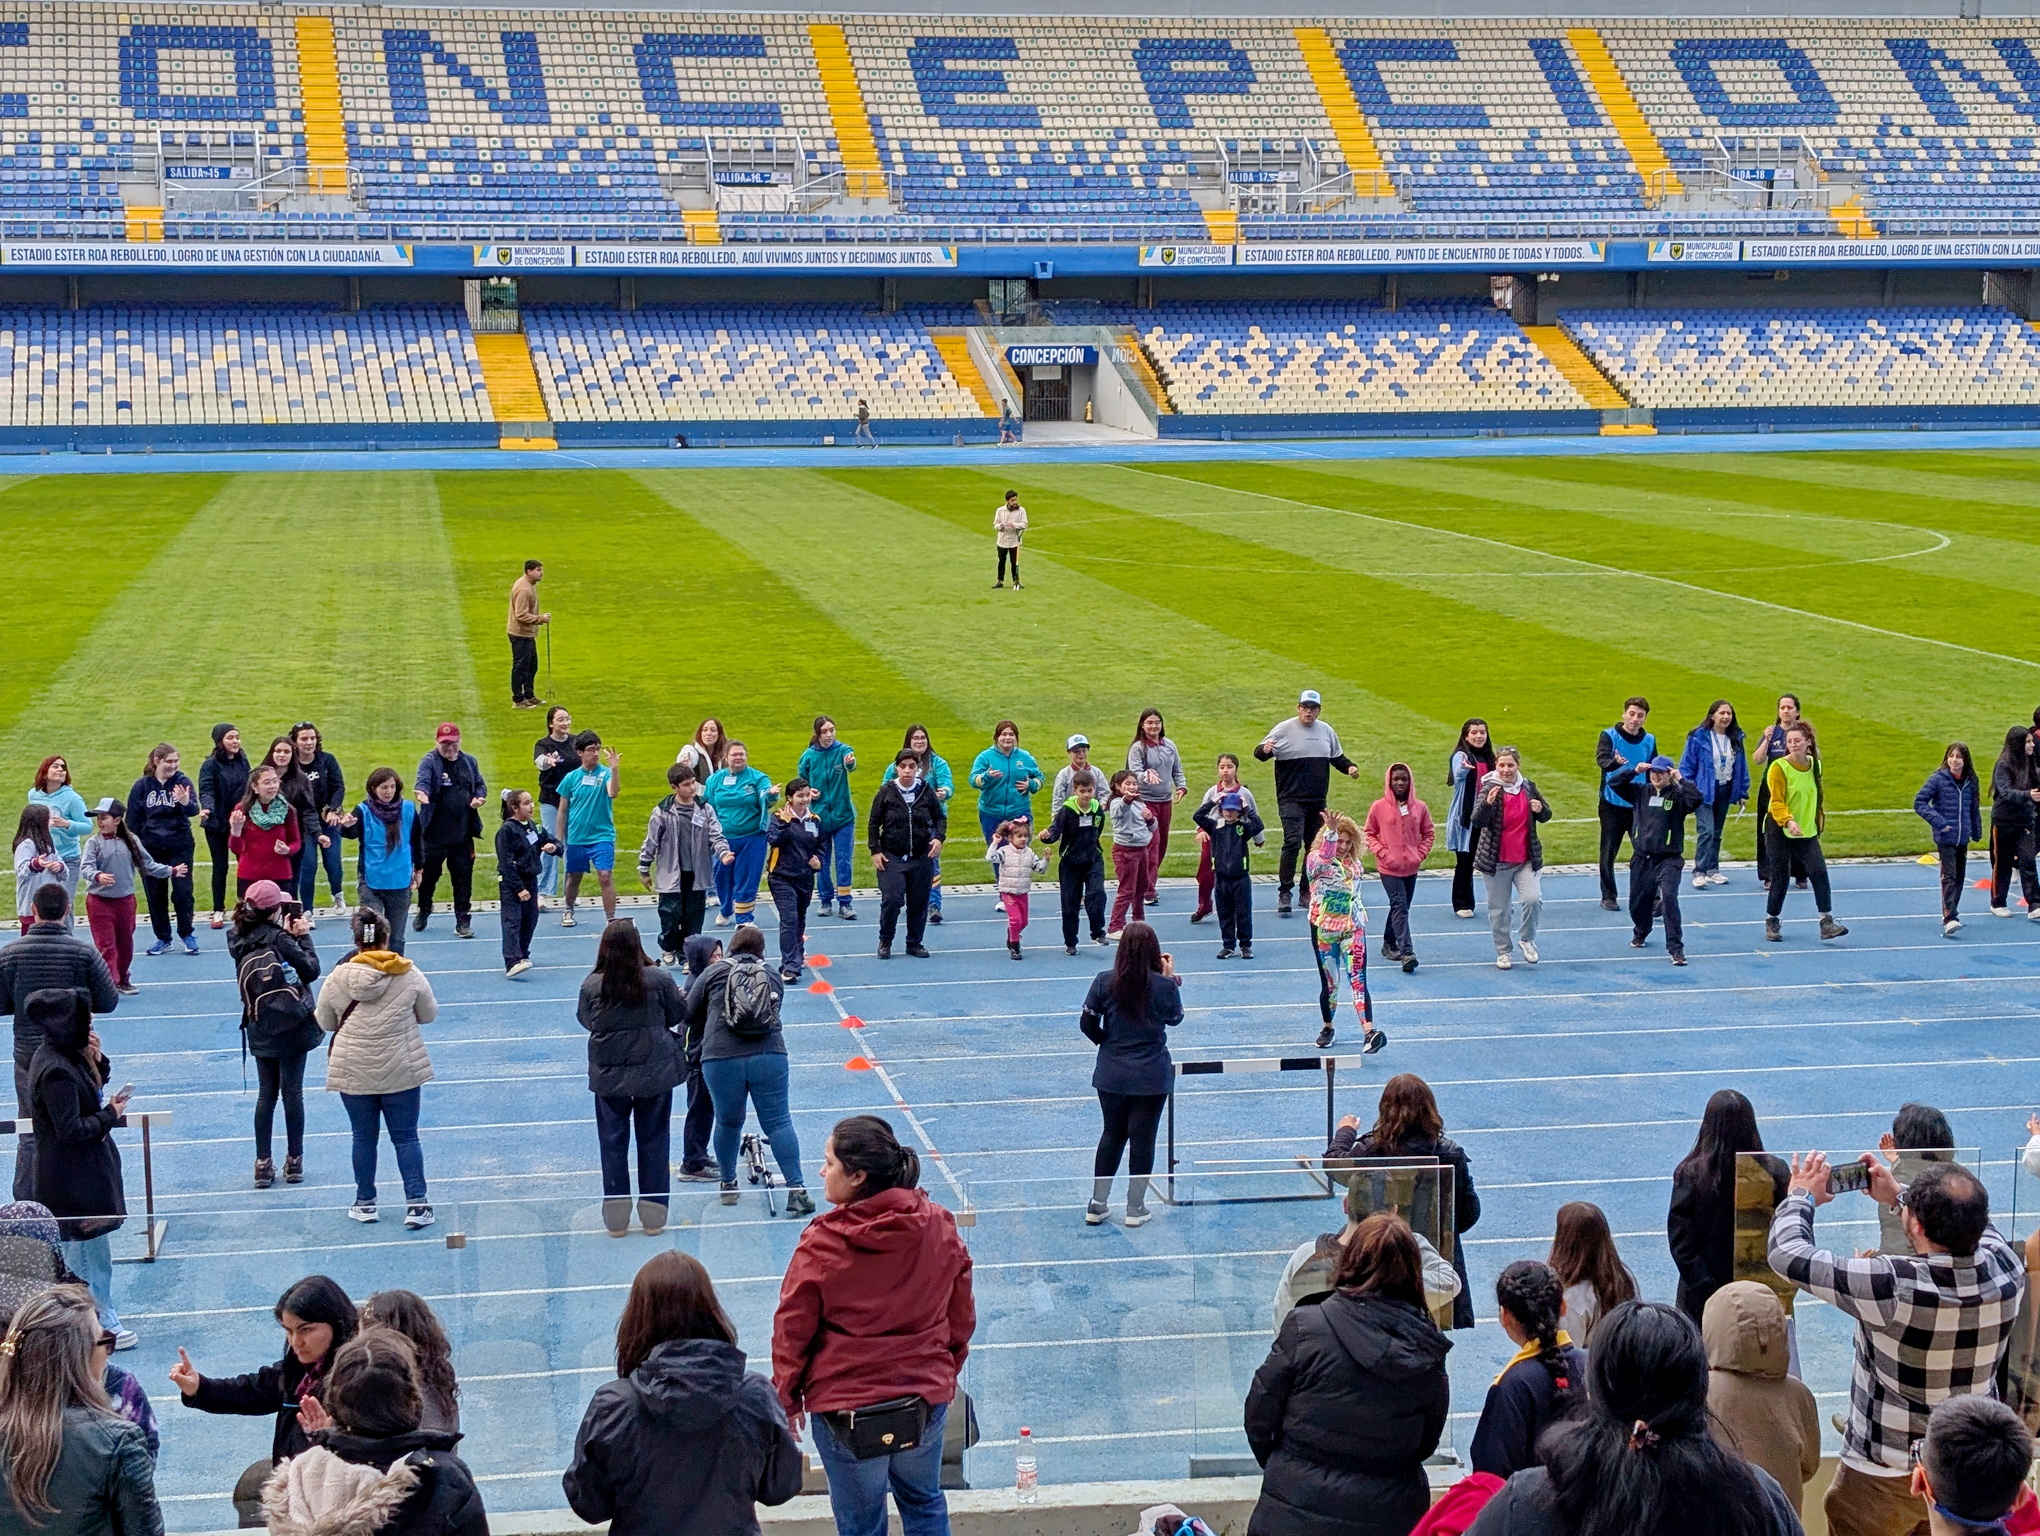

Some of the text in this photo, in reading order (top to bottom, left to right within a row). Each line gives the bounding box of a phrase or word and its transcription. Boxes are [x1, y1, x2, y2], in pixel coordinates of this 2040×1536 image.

[514, 246, 565, 255] MUNICIPALIDAD
[1178, 246, 1226, 255] MUNICIPALIDAD
[1686, 242, 1734, 250] MUNICIPALIDAD
[1751, 245, 1787, 257] ESTADIO
[1789, 245, 1816, 257] ESTER
[1818, 245, 1836, 257] ROA
[1838, 244, 1889, 257] REBOLLEDO,
[1891, 244, 1919, 256] LOGRO
[1920, 244, 1932, 256] DE
[1934, 243, 1952, 255] UNA
[1954, 242, 1990, 255] GESTIÓN
[1992, 243, 2010, 255] CON
[2011, 243, 2022, 255] LA
[11, 247, 384, 263] ESTADIO ESTER ROA REBOLLEDO, LOGRO DE UNA GESTIÓN CON LA CIUDADANÍA.
[585, 249, 935, 265] ESTADIO ESTER ROA REBOLLEDO, AQUÍ VIVIMOS JUNTOS Y DECIDIMOS JUNTOS.
[1177, 255, 1226, 264] DE CONCEPCIÓN
[1245, 247, 1585, 262] ESTADIO ESTER ROA REBOLLEDO, PUNTO DE ENCUENTRO DE TODAS Y TODOS.
[1685, 250, 1733, 260] DE CONCEPCIÓN
[514, 255, 565, 266] DE CONCEPCIÓN
[1011, 346, 1084, 364] CONCEPCIÓN
